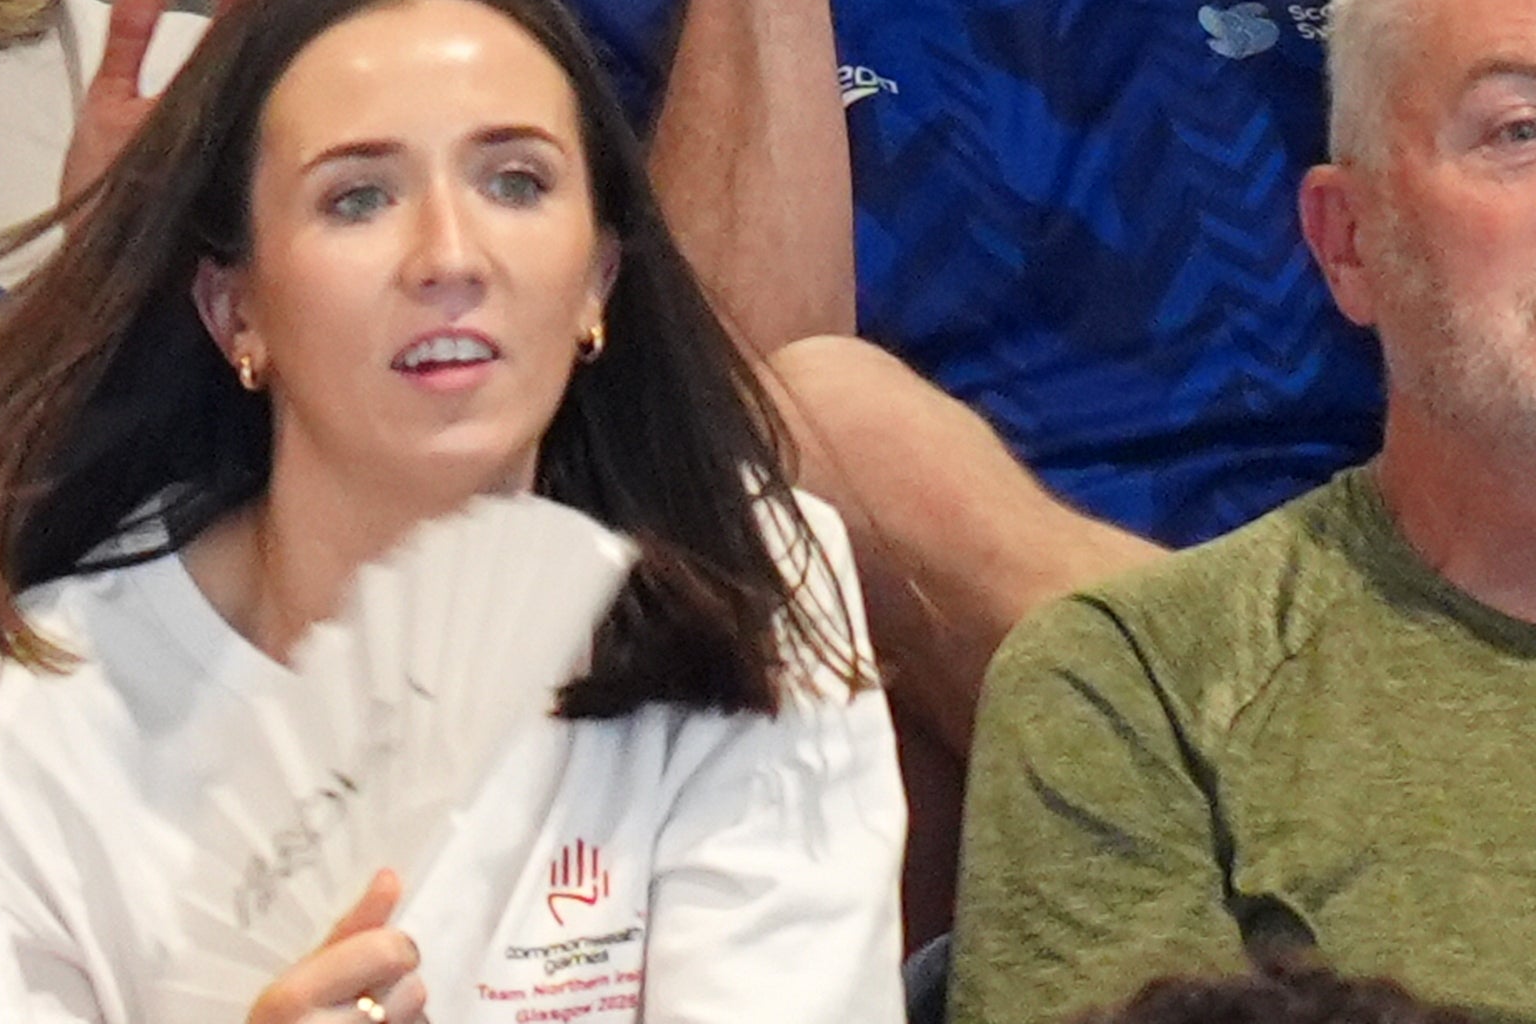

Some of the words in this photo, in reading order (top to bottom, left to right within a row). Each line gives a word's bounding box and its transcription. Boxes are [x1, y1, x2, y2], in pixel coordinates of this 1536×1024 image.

[544, 948, 609, 976] games
[475, 983, 526, 1001] Team
[516, 1004, 591, 1023] Glasgow
